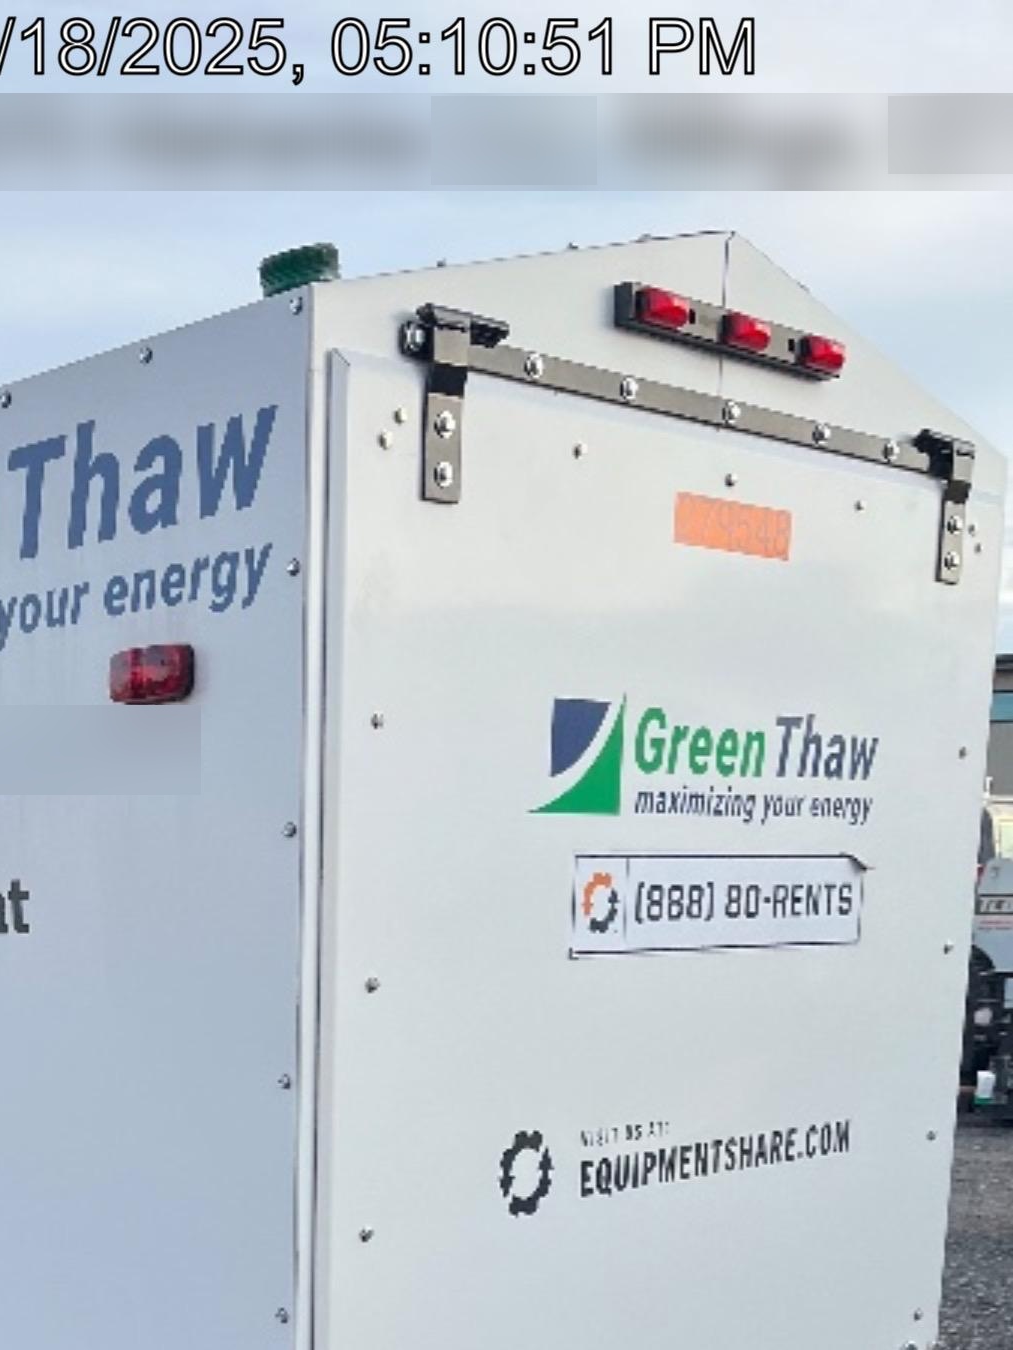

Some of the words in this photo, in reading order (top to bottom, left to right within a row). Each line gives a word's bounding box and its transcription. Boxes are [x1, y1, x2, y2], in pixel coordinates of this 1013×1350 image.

[103, 542, 274, 614] energy
[634, 786, 755, 824] maximizing
[760, 794, 806, 826] your
[809, 797, 874, 826] energy
[634, 881, 715, 925] (888)
[724, 883, 853, 920] 80-RENTS
[580, 1120, 850, 1198] EQUIPMENTSHARE.COM
